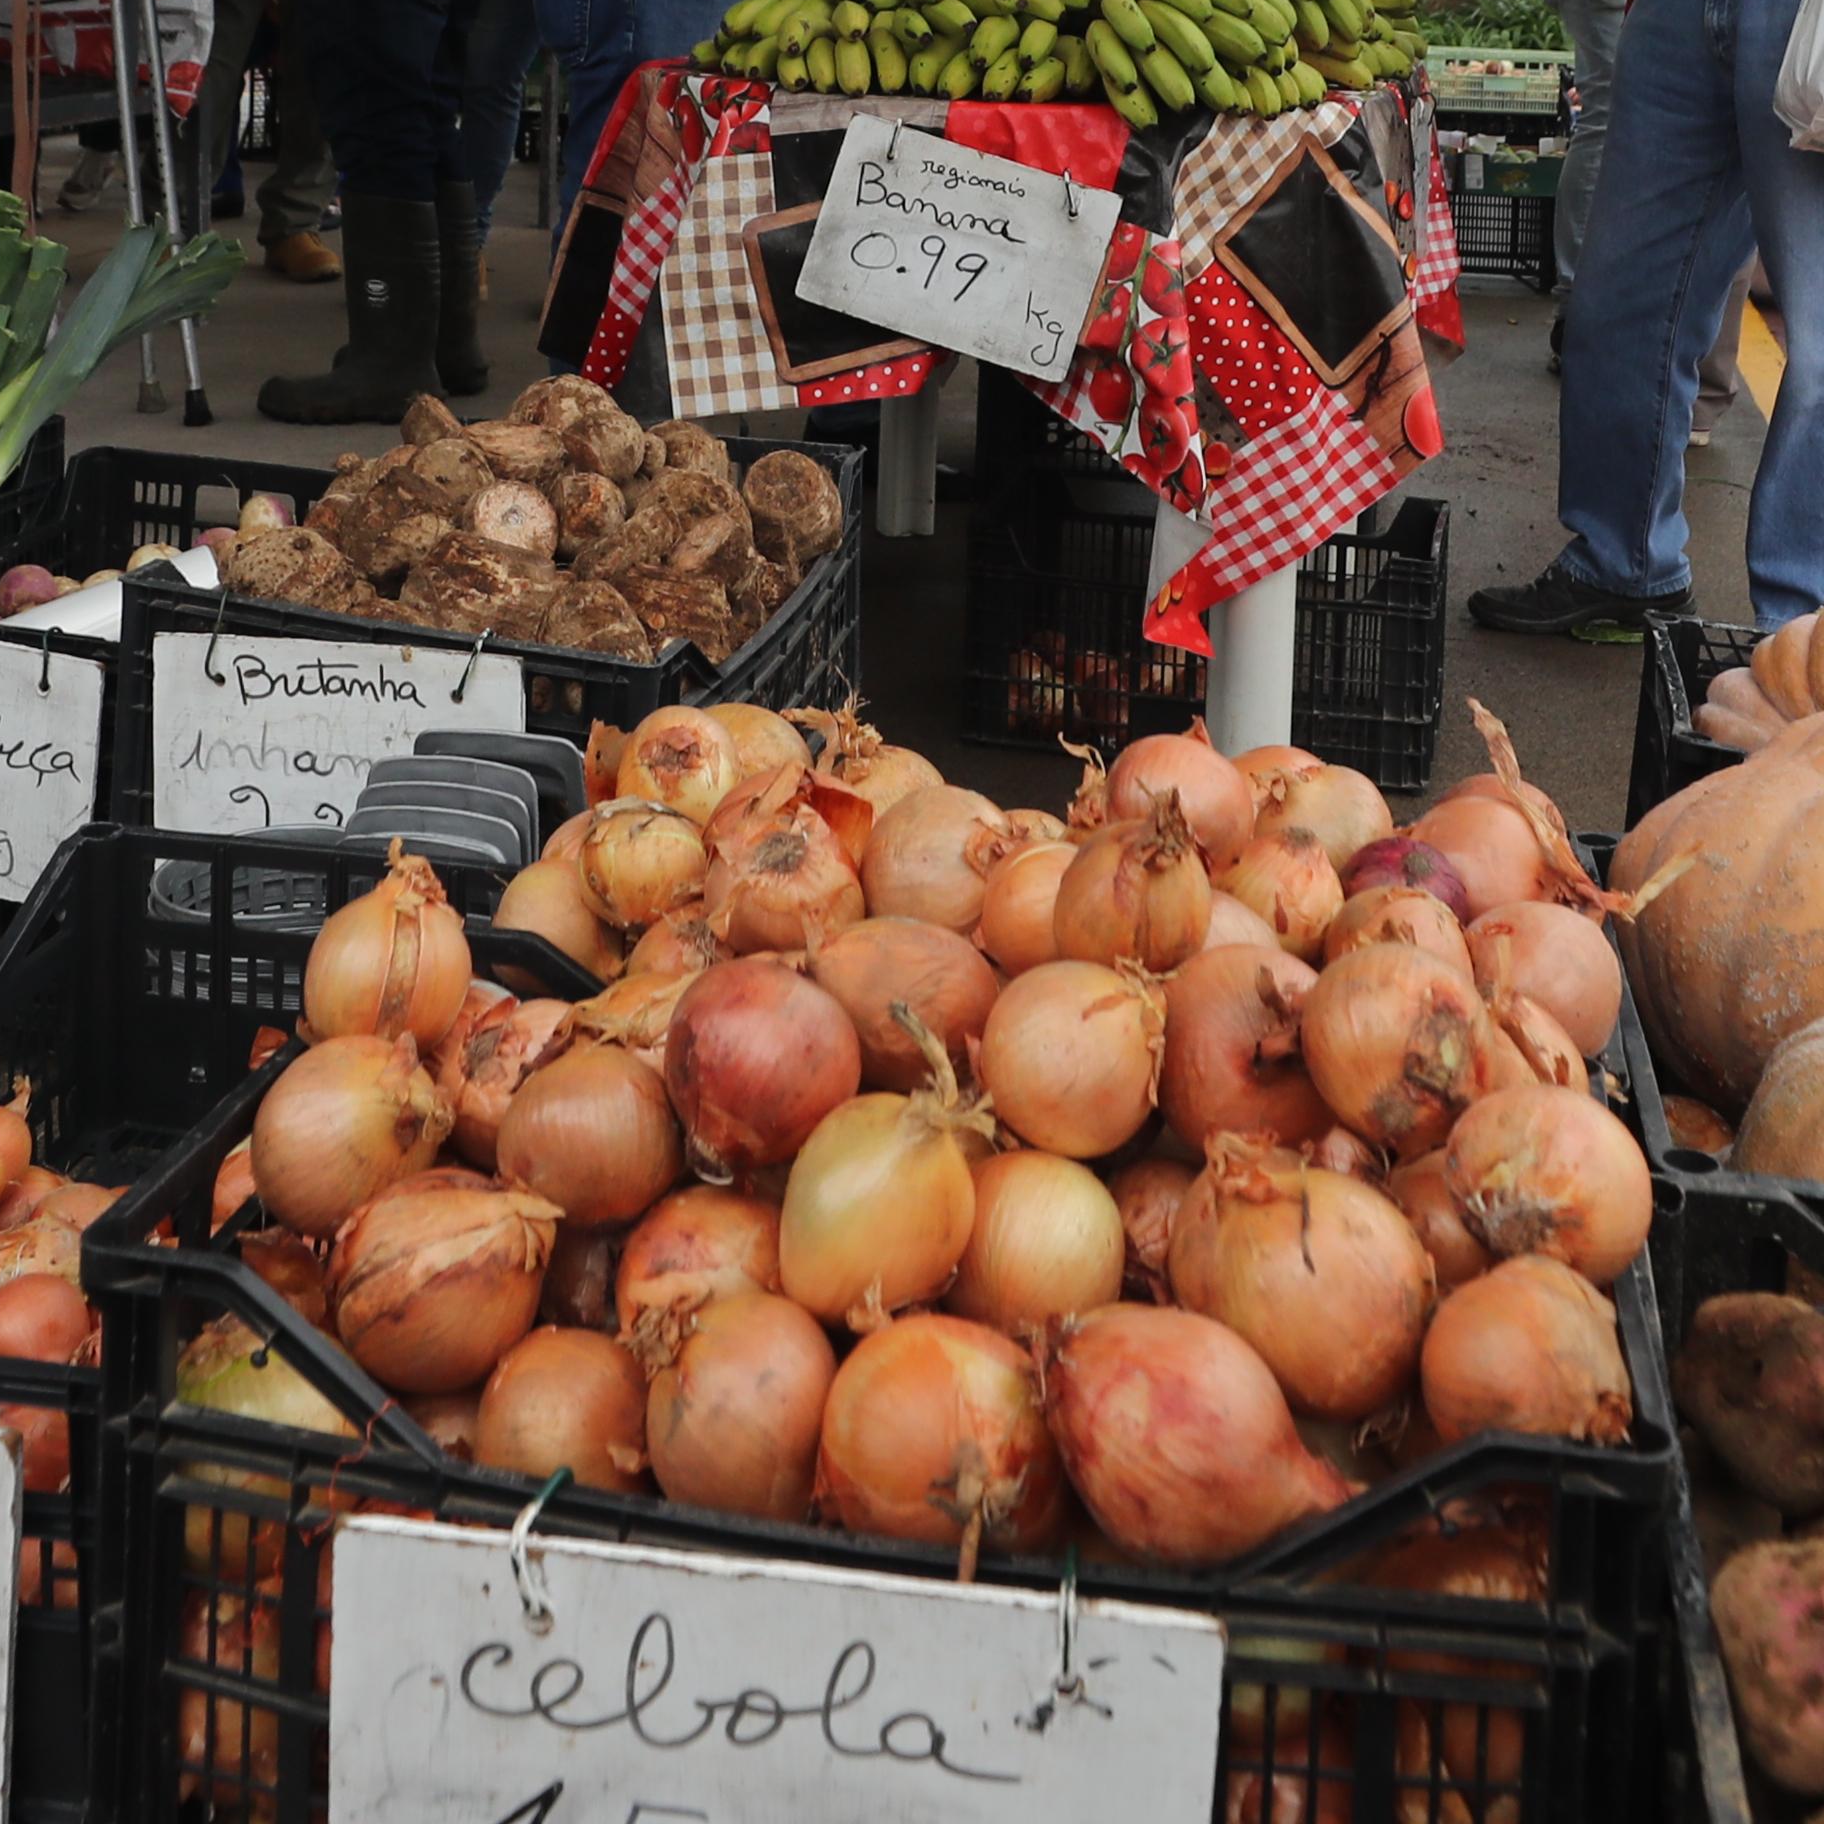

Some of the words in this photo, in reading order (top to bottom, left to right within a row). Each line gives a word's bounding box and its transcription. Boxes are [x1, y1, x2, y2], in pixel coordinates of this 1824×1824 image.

[855, 161, 1027, 244] Banana
[850, 231, 988, 302] 0.99
[460, 1612, 1022, 1783] cebola
